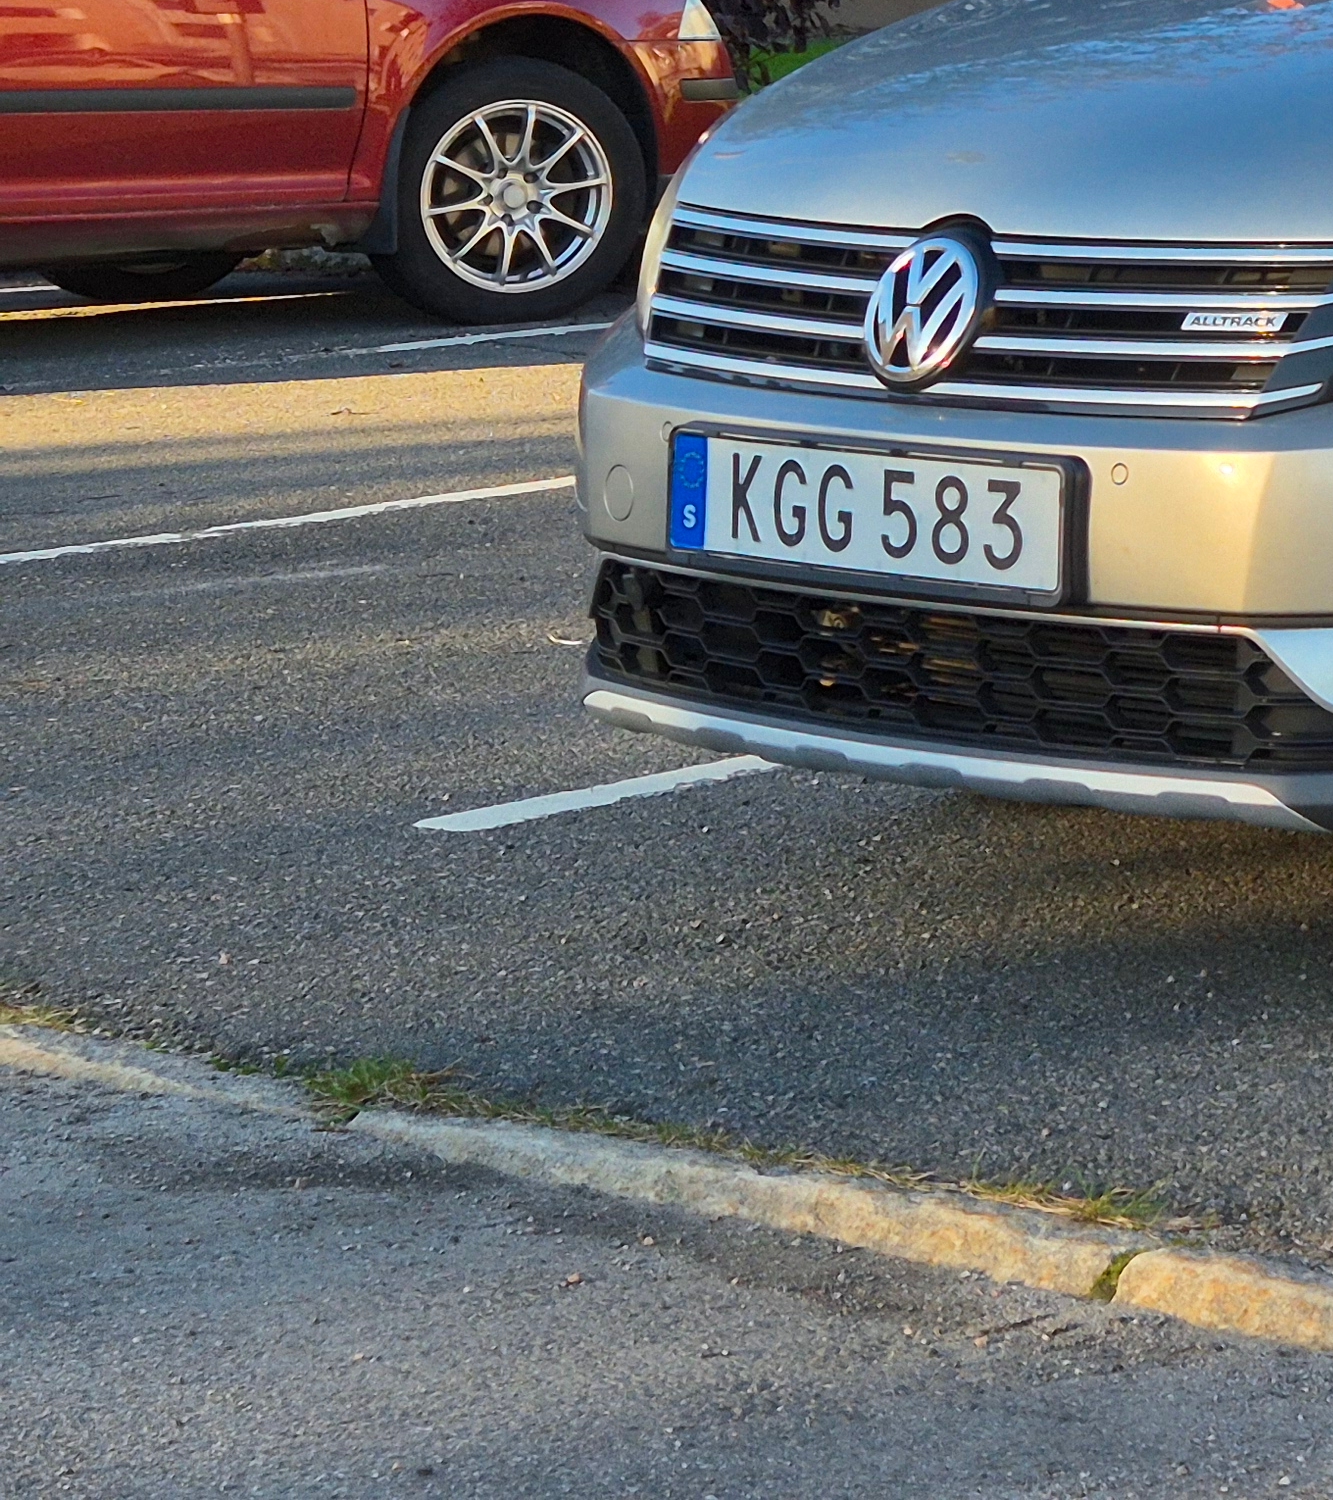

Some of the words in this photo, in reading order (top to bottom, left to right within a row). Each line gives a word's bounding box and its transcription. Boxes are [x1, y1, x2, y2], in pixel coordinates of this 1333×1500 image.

[1189, 316, 1277, 327] ALLTRACK
[682, 504, 697, 529] S
[731, 452, 854, 553] KGG
[880, 469, 1024, 571] 583
